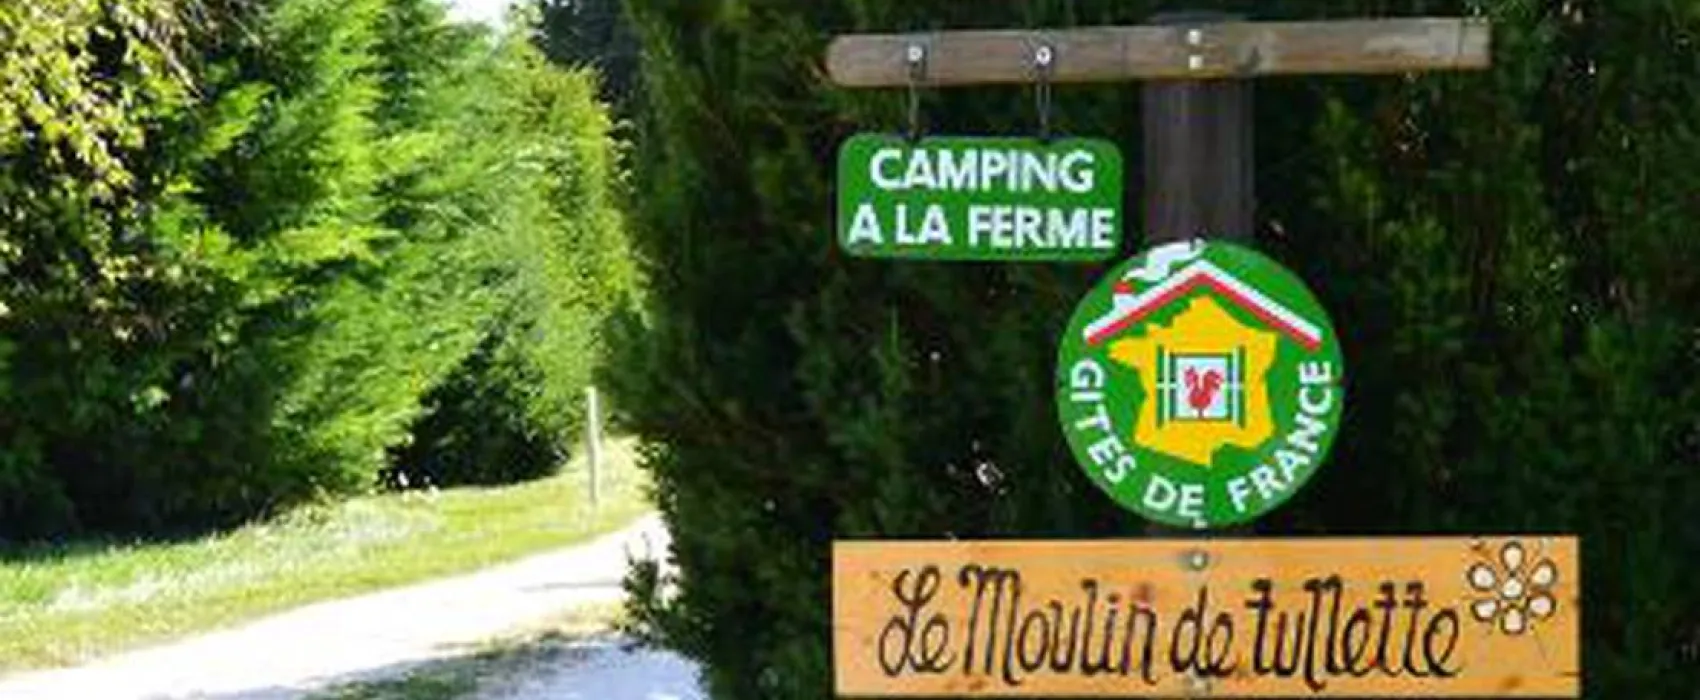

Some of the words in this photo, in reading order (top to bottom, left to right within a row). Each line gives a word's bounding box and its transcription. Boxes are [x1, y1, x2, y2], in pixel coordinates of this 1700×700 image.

[869, 148, 1096, 193] CAMPING
[848, 203, 883, 245] A
[895, 203, 952, 245] LA
[967, 205, 1116, 249] FERME
[1070, 358, 1136, 483] GITES
[1143, 475, 1205, 518] DE
[1226, 360, 1332, 512] FRANCE
[878, 565, 956, 677] Le
[958, 563, 1160, 686] Moulin
[1169, 585, 1238, 677] de
